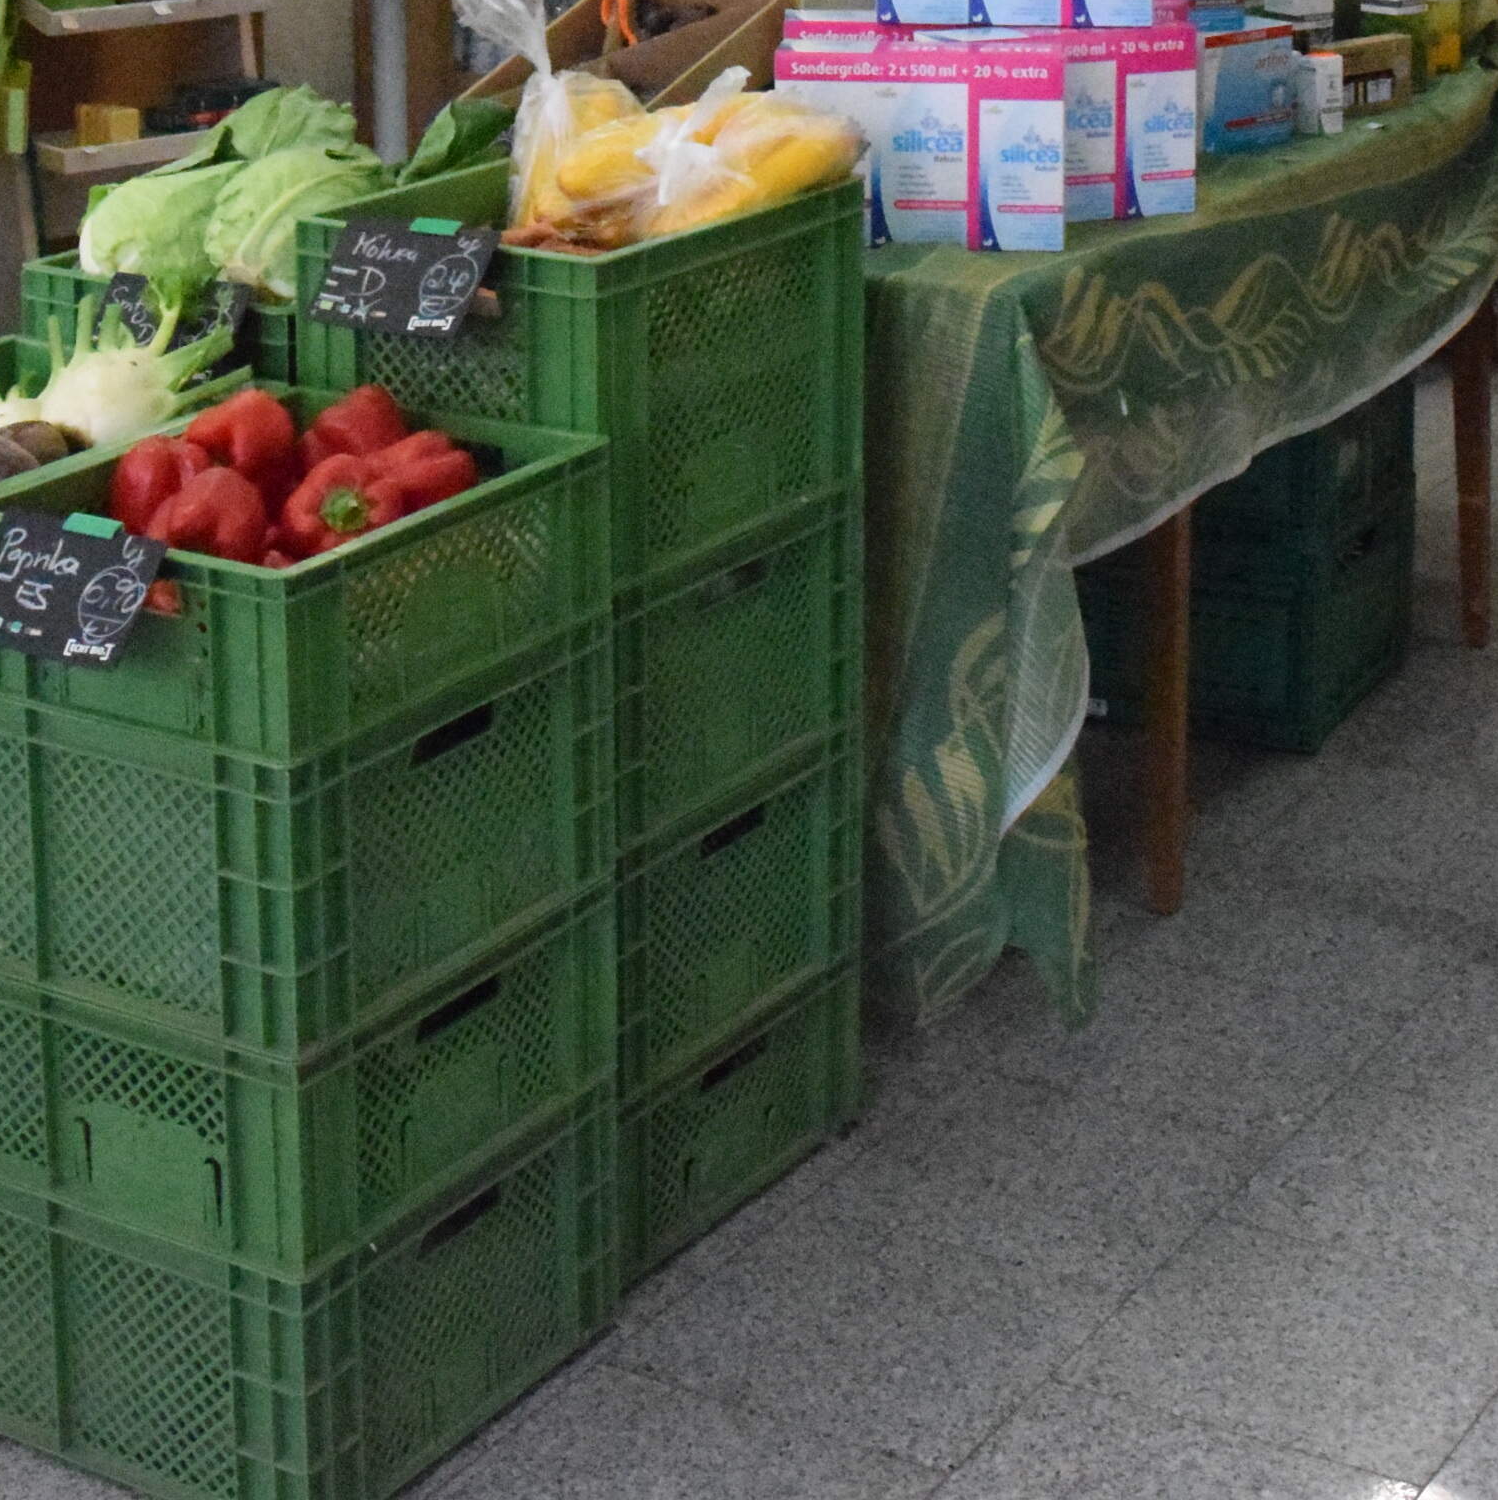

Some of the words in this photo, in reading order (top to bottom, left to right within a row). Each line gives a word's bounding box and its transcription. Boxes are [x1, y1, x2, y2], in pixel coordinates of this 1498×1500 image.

[1120, 40, 1137, 55] 20
[1152, 38, 1185, 53] extra
[790, 61, 884, 78] Sondergröße:
[888, 63, 897, 77] 2
[899, 66, 907, 77] x
[910, 63, 936, 77] 500
[938, 62, 958, 77] ml
[972, 64, 991, 78] 20
[993, 64, 1009, 79] %
[1011, 65, 1048, 79] extra
[1143, 112, 1194, 135] silicea
[892, 128, 964, 153] silicea
[999, 143, 1061, 165] silicea
